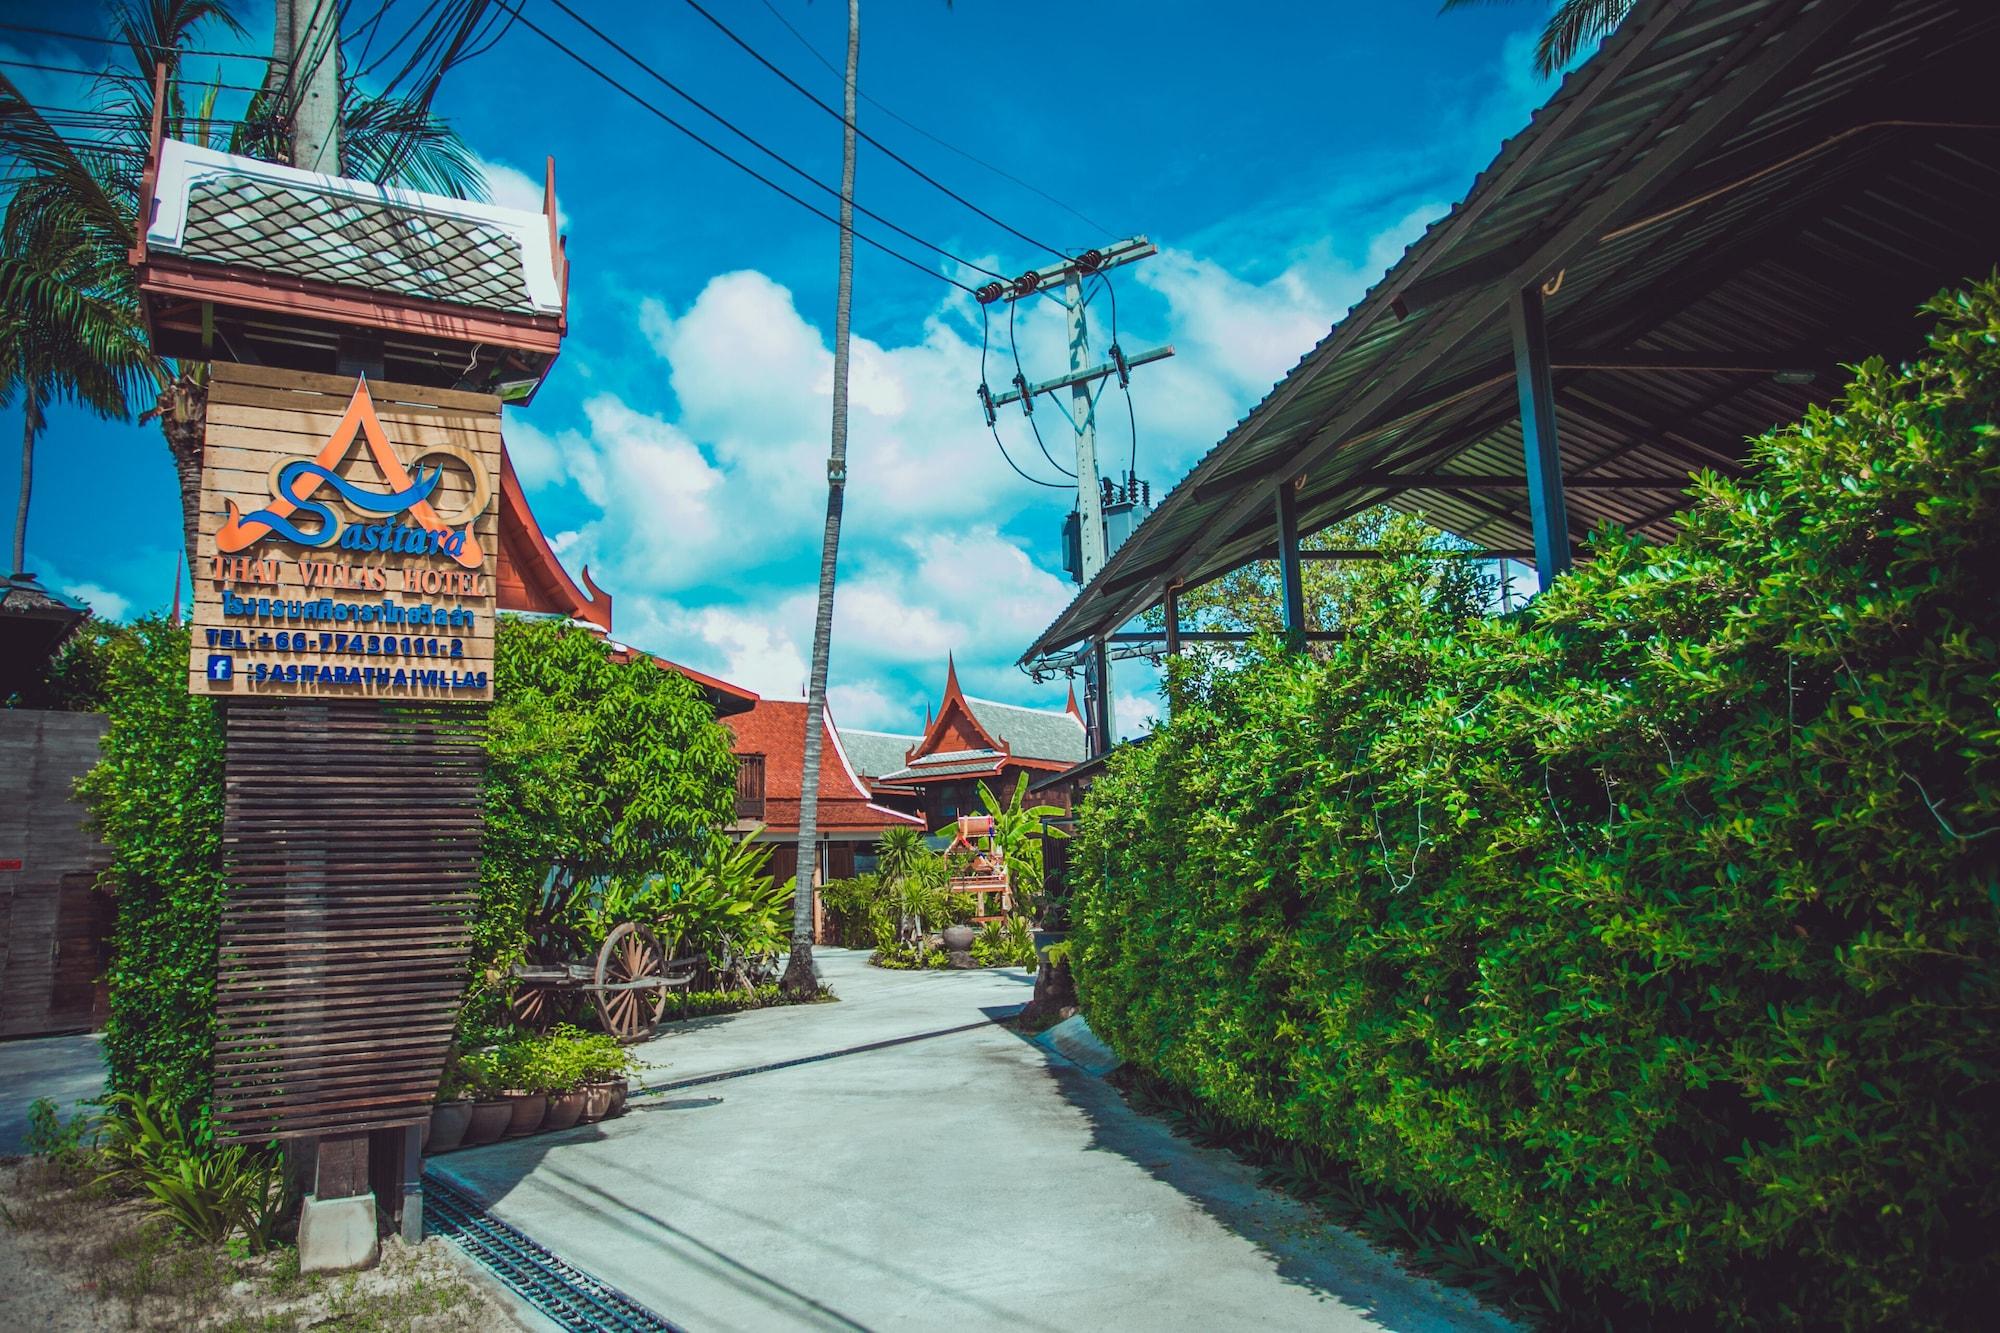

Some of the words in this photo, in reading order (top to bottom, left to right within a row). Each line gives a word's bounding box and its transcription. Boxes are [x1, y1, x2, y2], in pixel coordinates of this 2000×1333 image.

[212, 555, 280, 583] THAI
[299, 559, 387, 591] VILLAS
[402, 567, 483, 596] HOTEL
